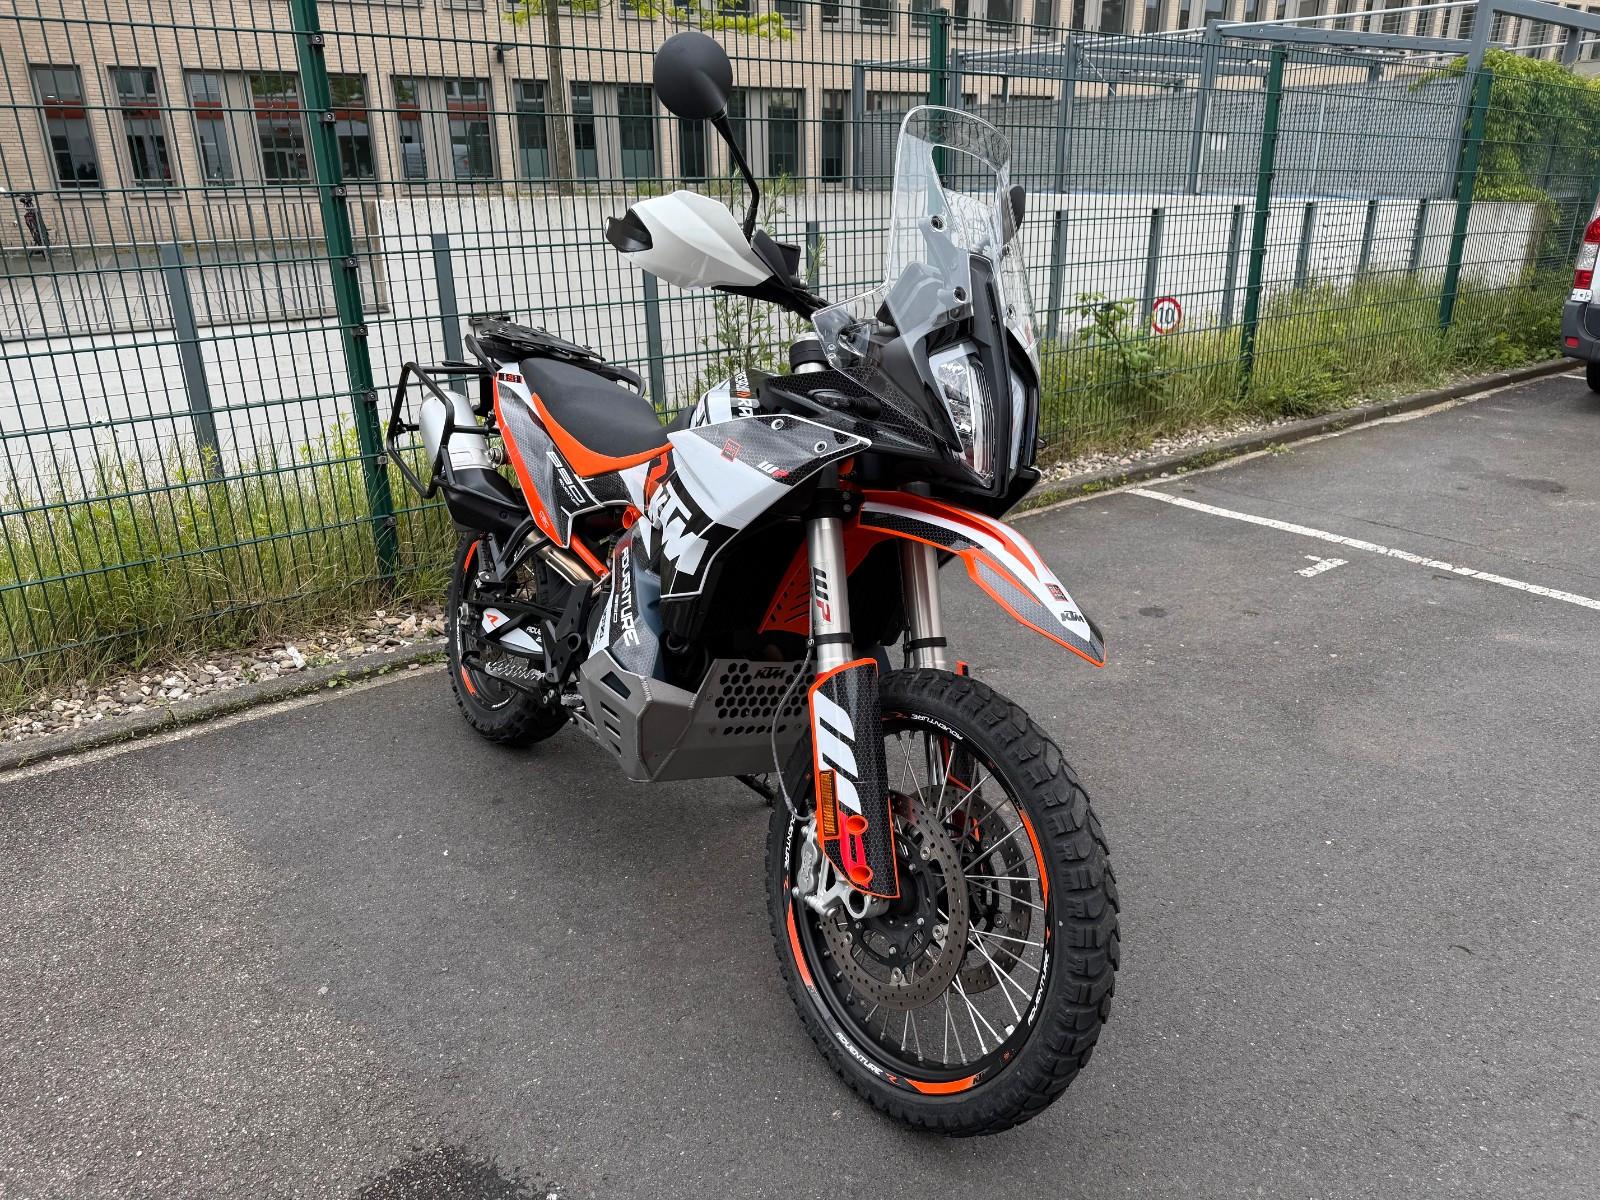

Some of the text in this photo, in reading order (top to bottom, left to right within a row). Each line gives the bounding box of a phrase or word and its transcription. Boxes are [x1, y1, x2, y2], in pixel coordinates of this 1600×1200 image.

[1158, 307, 1175, 325] 10
[647, 479, 709, 576] KTM
[620, 546, 640, 647] ADVENTURE
[1060, 610, 1085, 624] KTM
[753, 666, 786, 679] KTM
[911, 713, 963, 741] ADVENTURE
[835, 1032, 883, 1075] ADVENTURE
